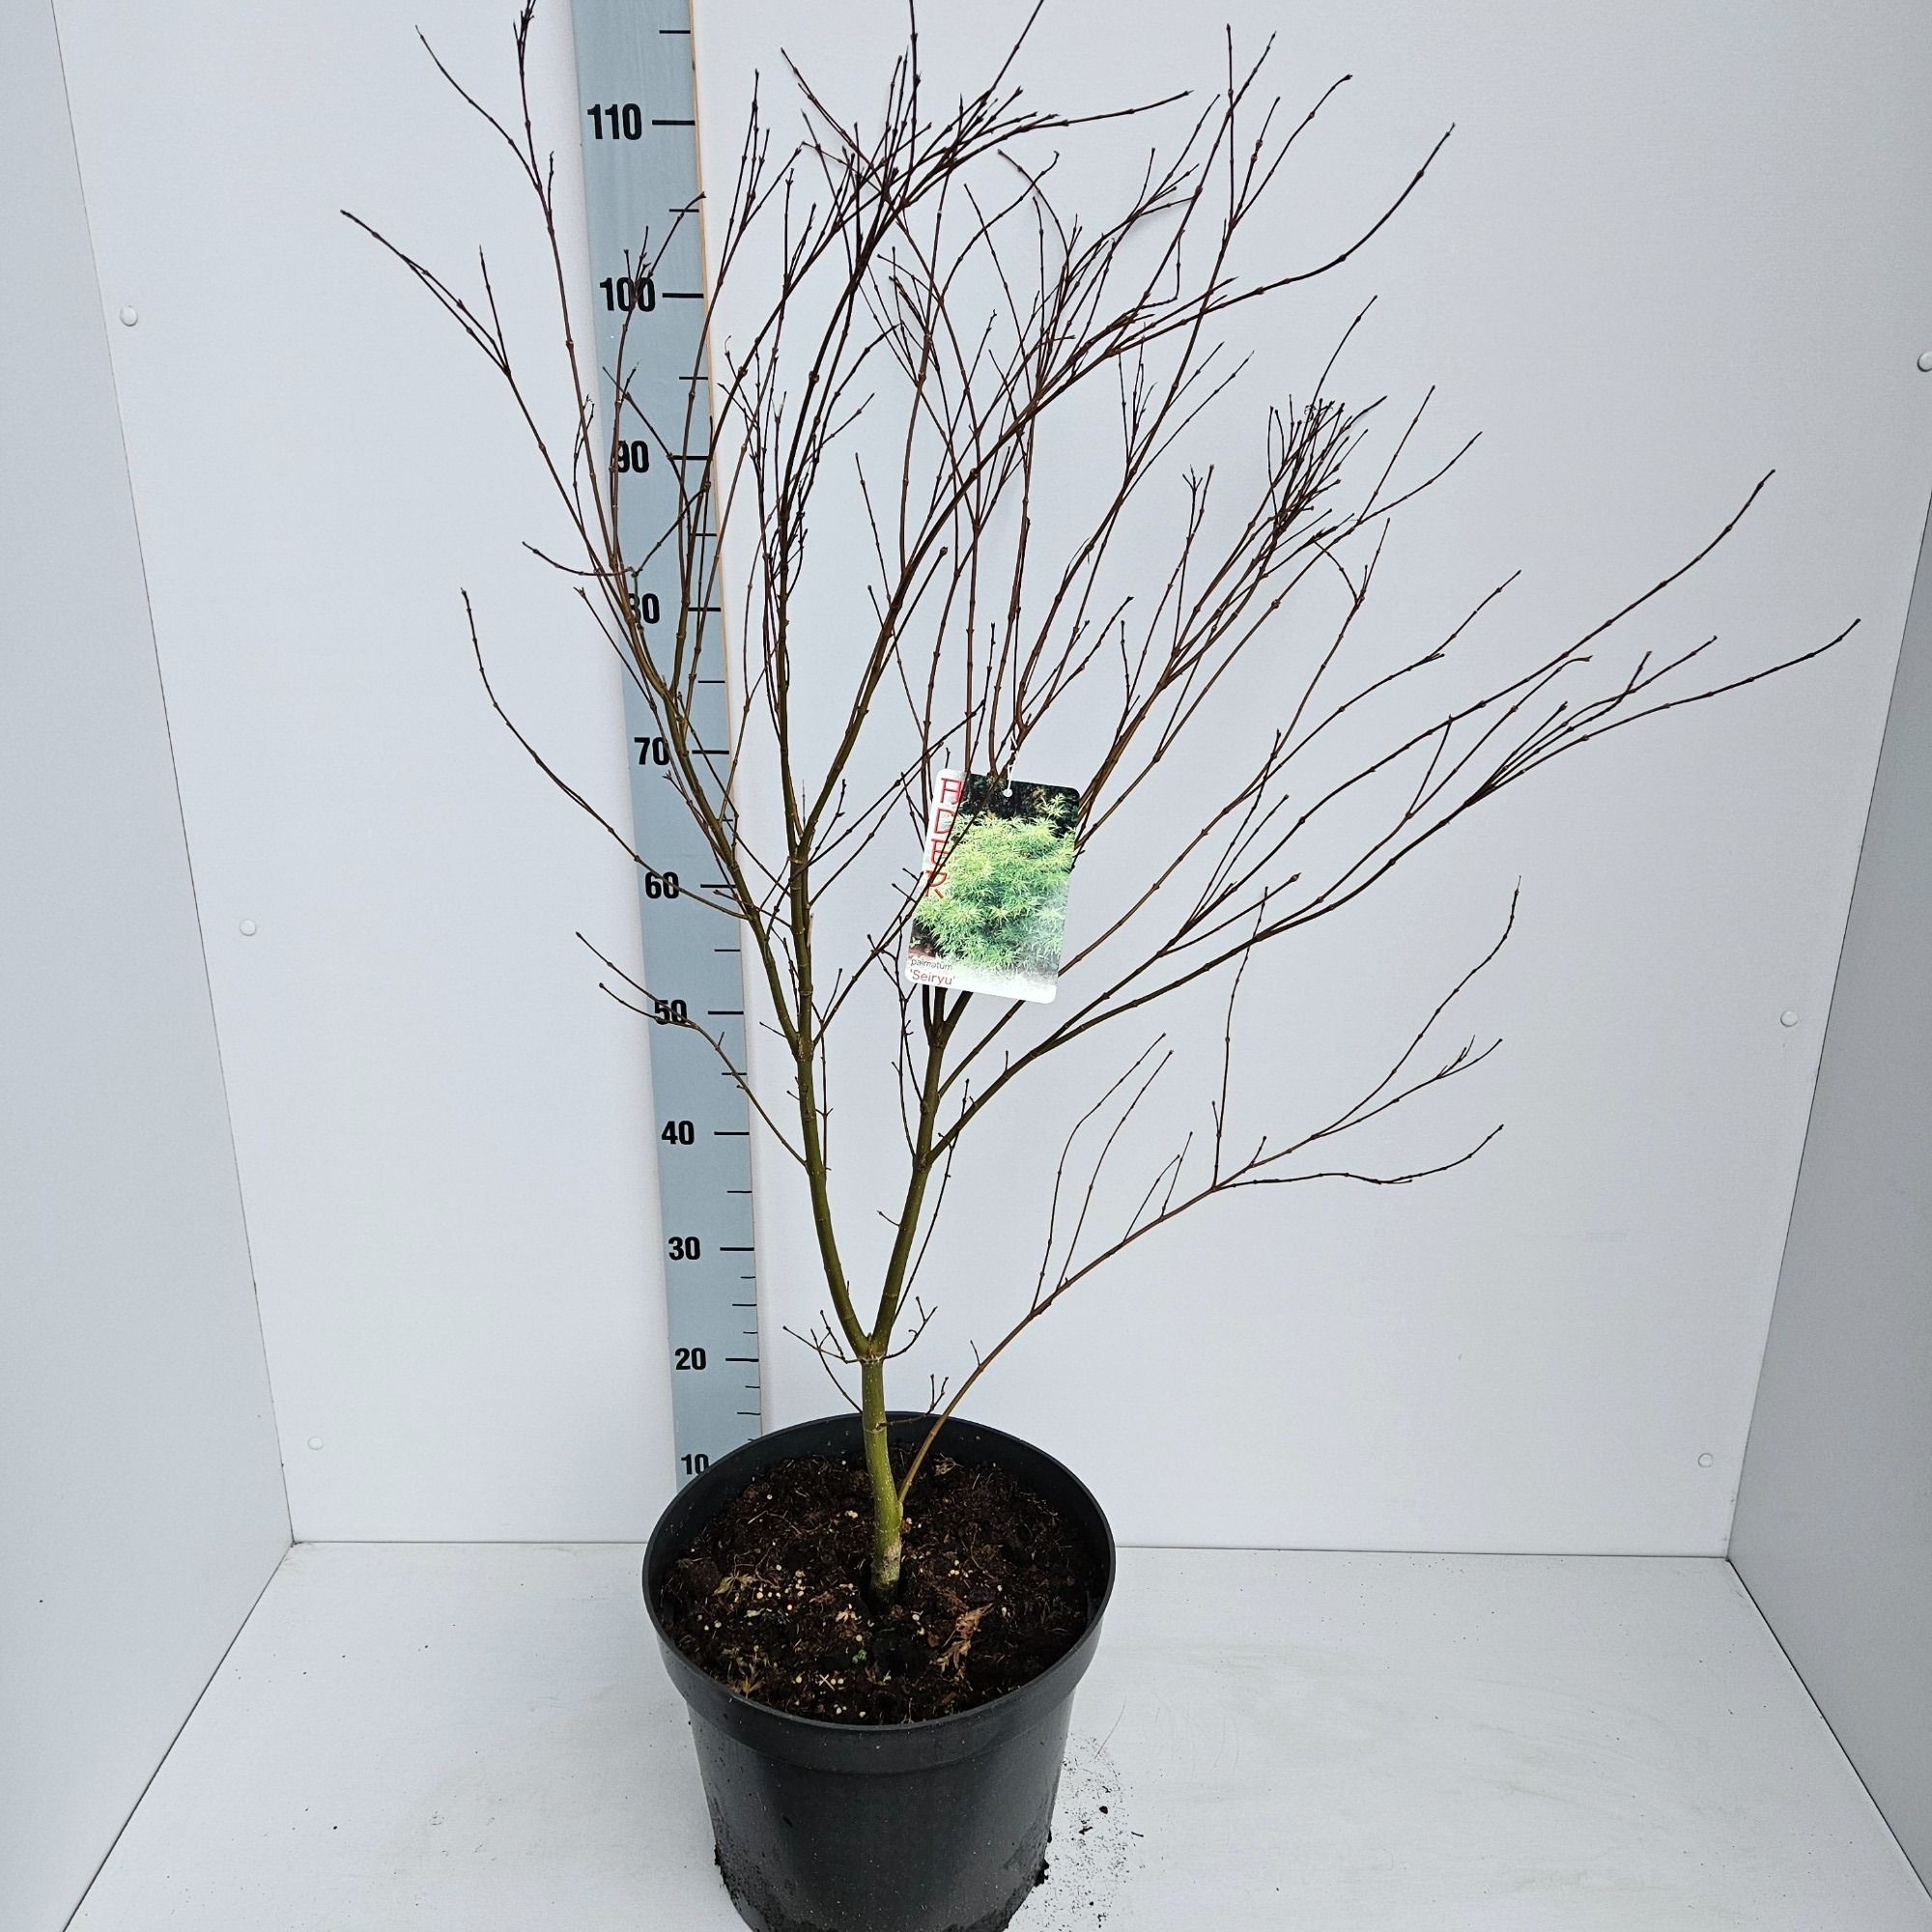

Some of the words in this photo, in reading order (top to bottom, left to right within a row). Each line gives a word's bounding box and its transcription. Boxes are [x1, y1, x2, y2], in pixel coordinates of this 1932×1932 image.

[586, 103, 642, 140] 110
[599, 276, 656, 312] 100
[634, 736, 669, 765] 70
[645, 871, 680, 899] 60
[910, 969, 956, 986] 'Seiryu'
[654, 999, 688, 1025] 50
[661, 1120, 695, 1146] 40
[668, 1236, 700, 1261] 30
[674, 1347, 706, 1371] 20
[680, 1453, 710, 1475] 10
